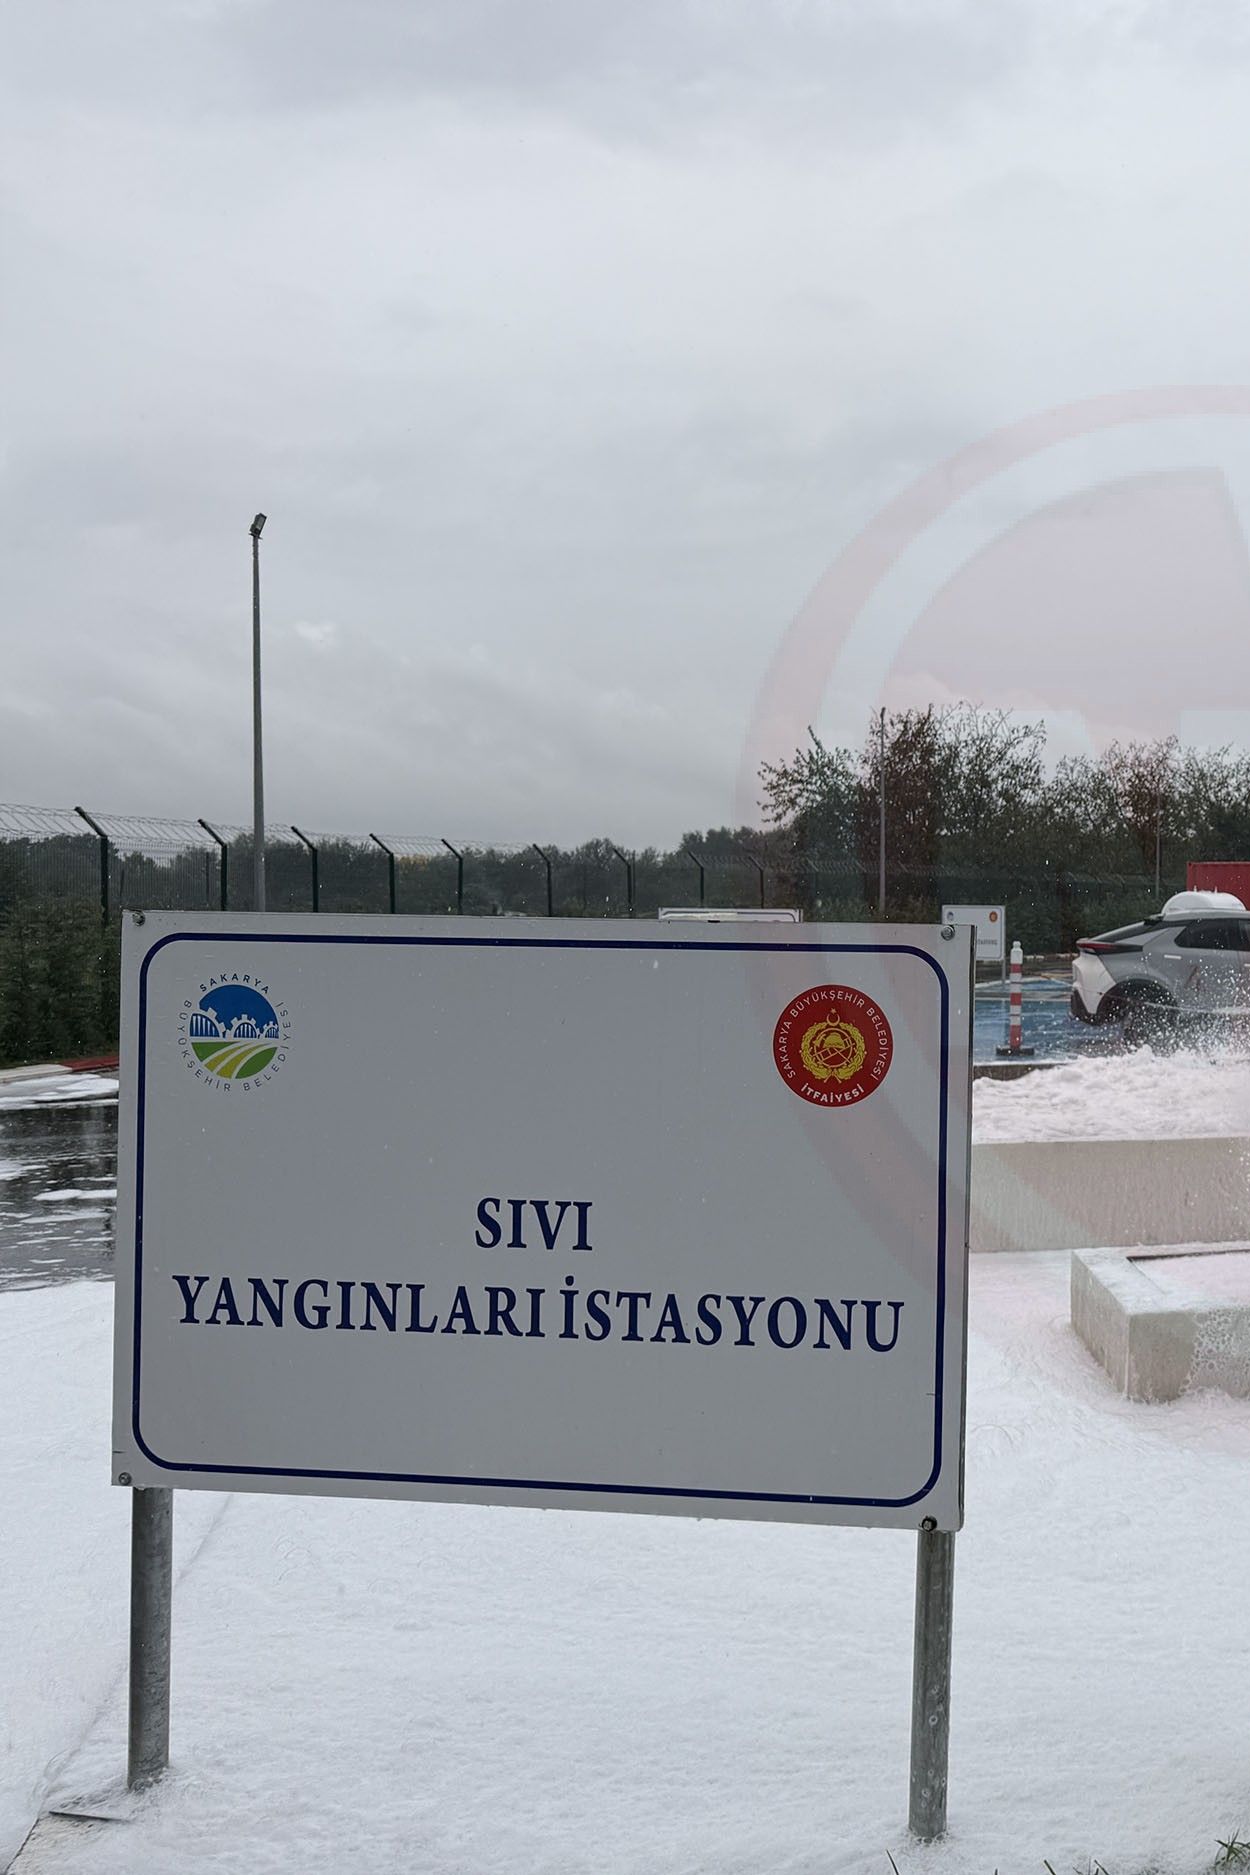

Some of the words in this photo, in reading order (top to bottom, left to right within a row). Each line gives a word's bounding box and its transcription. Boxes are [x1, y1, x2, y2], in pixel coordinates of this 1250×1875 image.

[199, 972, 270, 995] SAKARYA
[778, 1021, 797, 1080] SAKARYA
[800, 1082, 866, 1104] İTFAİYESİ
[474, 1196, 594, 1252] SIVI
[172, 1274, 547, 1340] YANGINLARI
[559, 1274, 905, 1354] İSTASYONU
